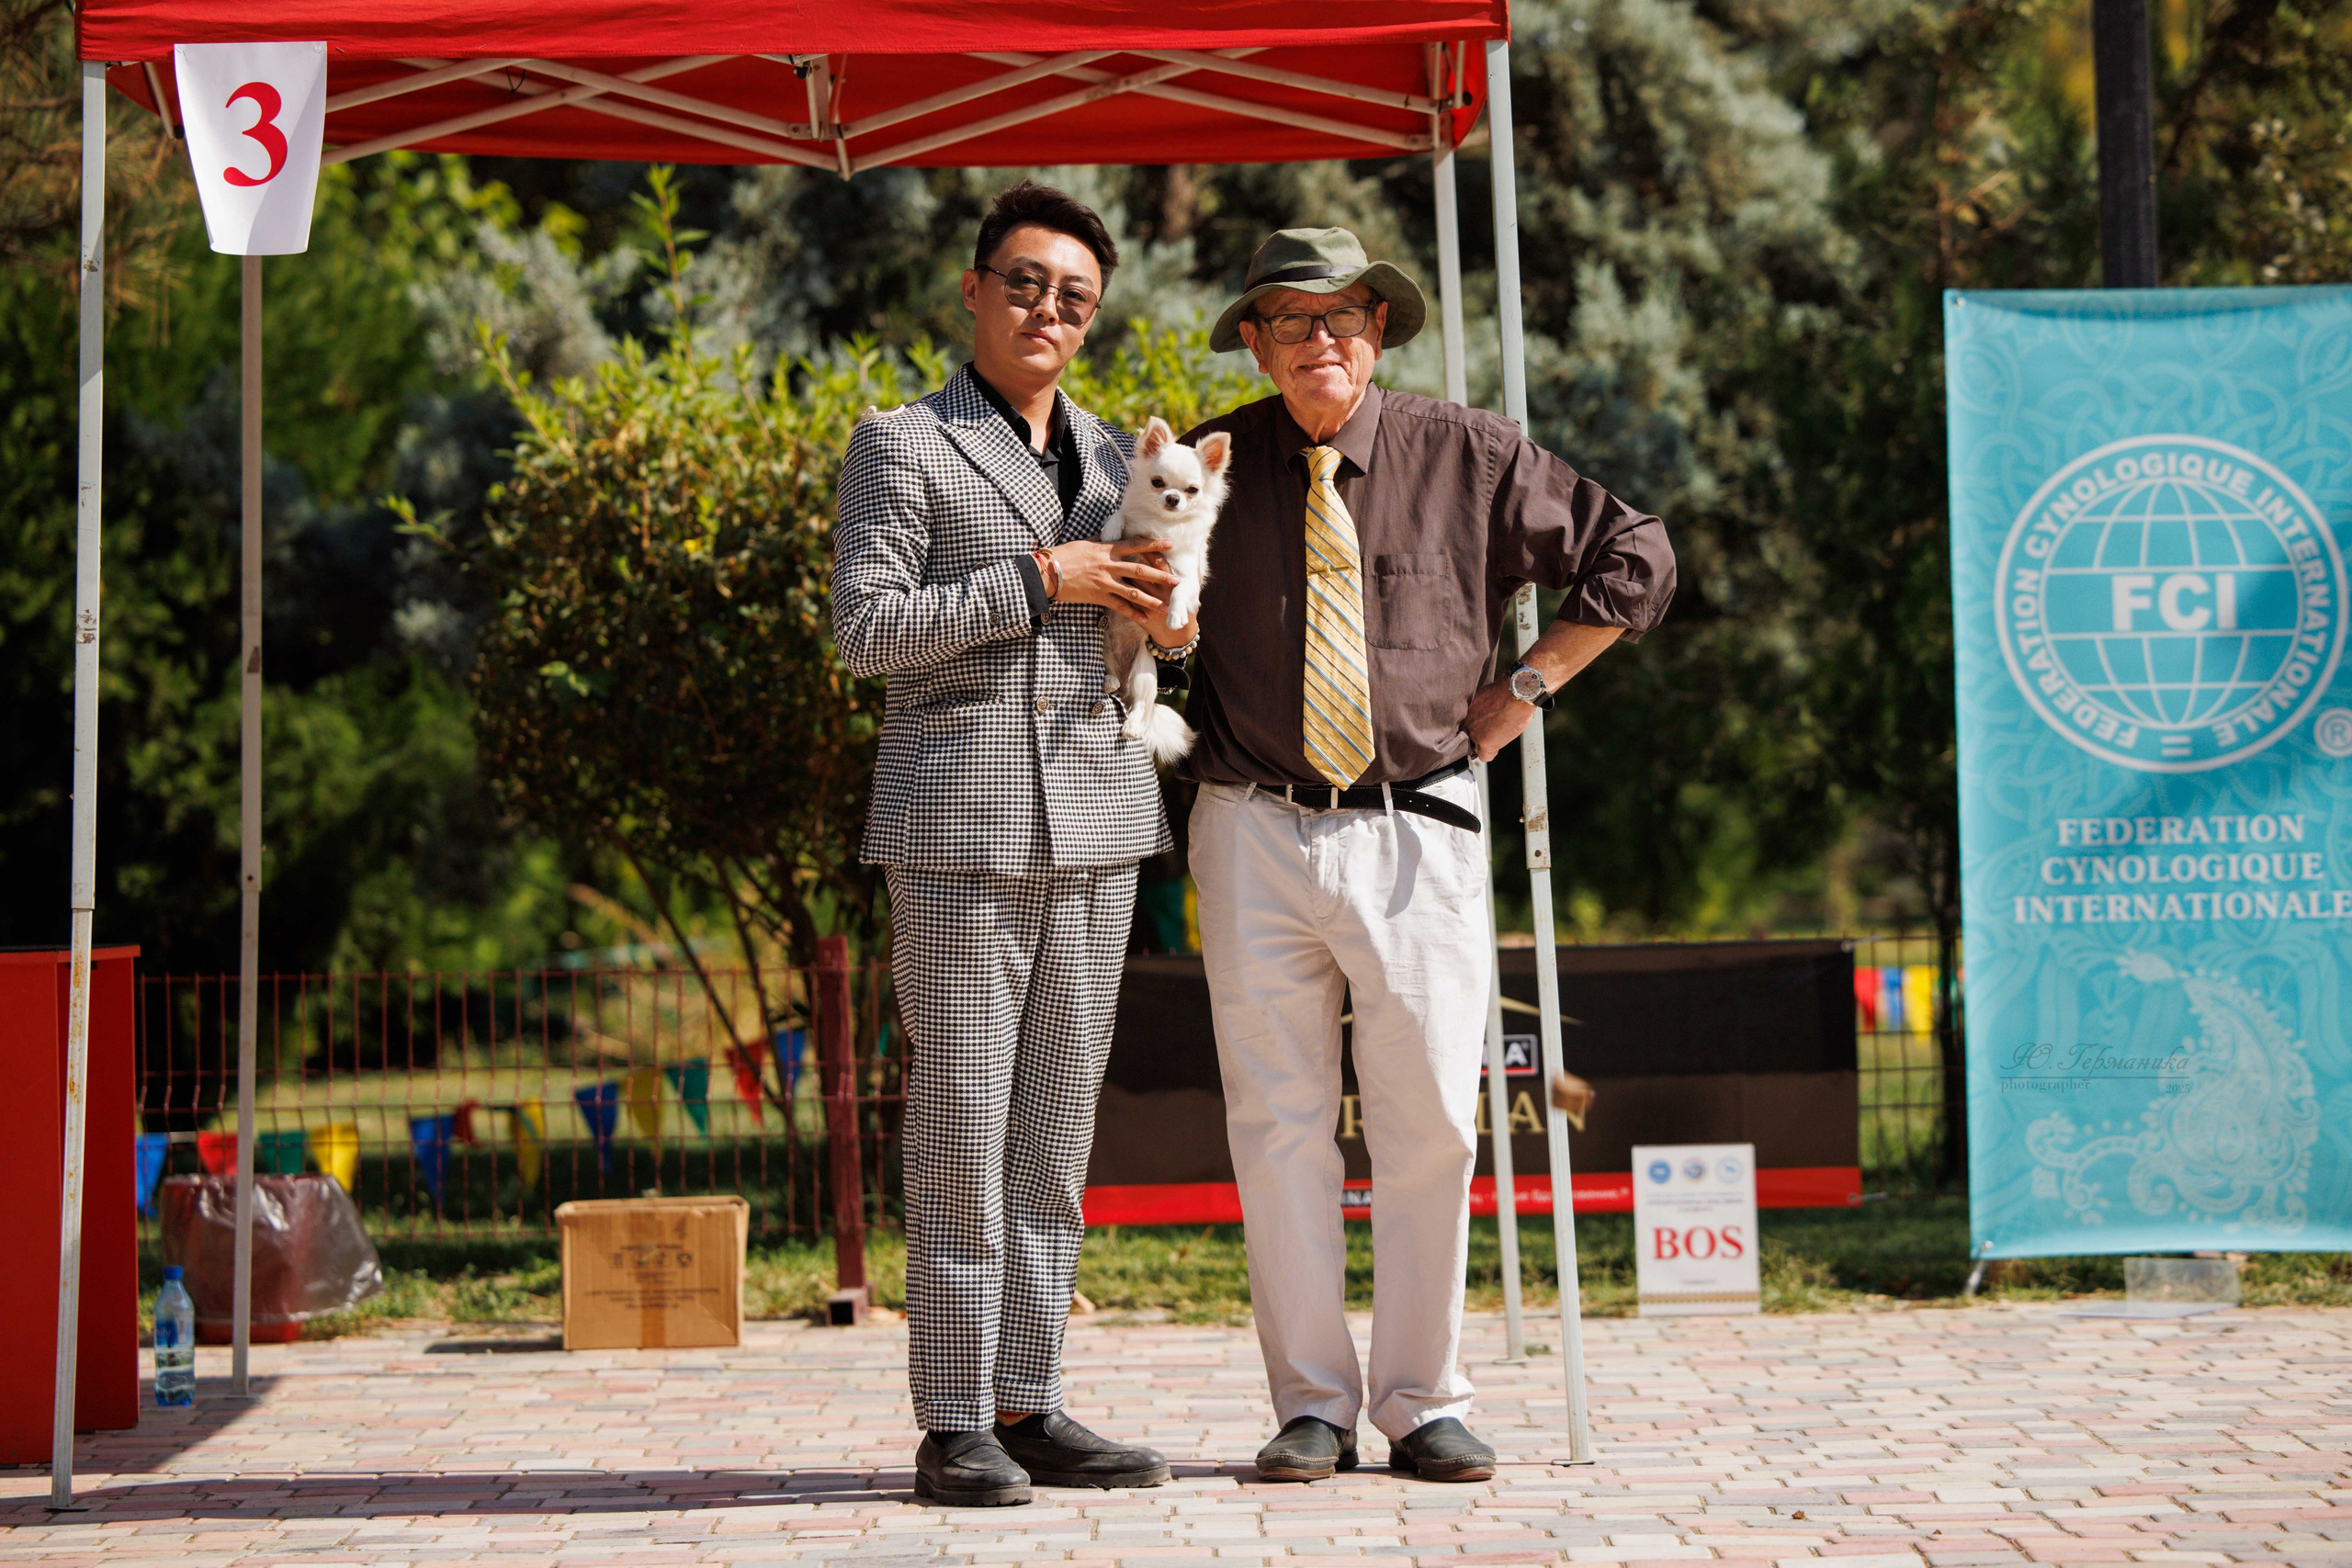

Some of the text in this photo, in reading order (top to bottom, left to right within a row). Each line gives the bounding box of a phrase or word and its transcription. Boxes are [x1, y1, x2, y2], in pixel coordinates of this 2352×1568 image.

[223, 81, 288, 187] 3
[2012, 451, 2331, 750] FEDERATION CYNOLOGIQUE INTERNATIONALE
[2112, 572, 2238, 632] FCI
[2056, 814, 2306, 847] FEDERATION
[2040, 852, 2324, 886] CYNOLOGIQUE
[2013, 890, 2352, 924] INTERNATIONALE
[1653, 1225, 1744, 1259] BOS
